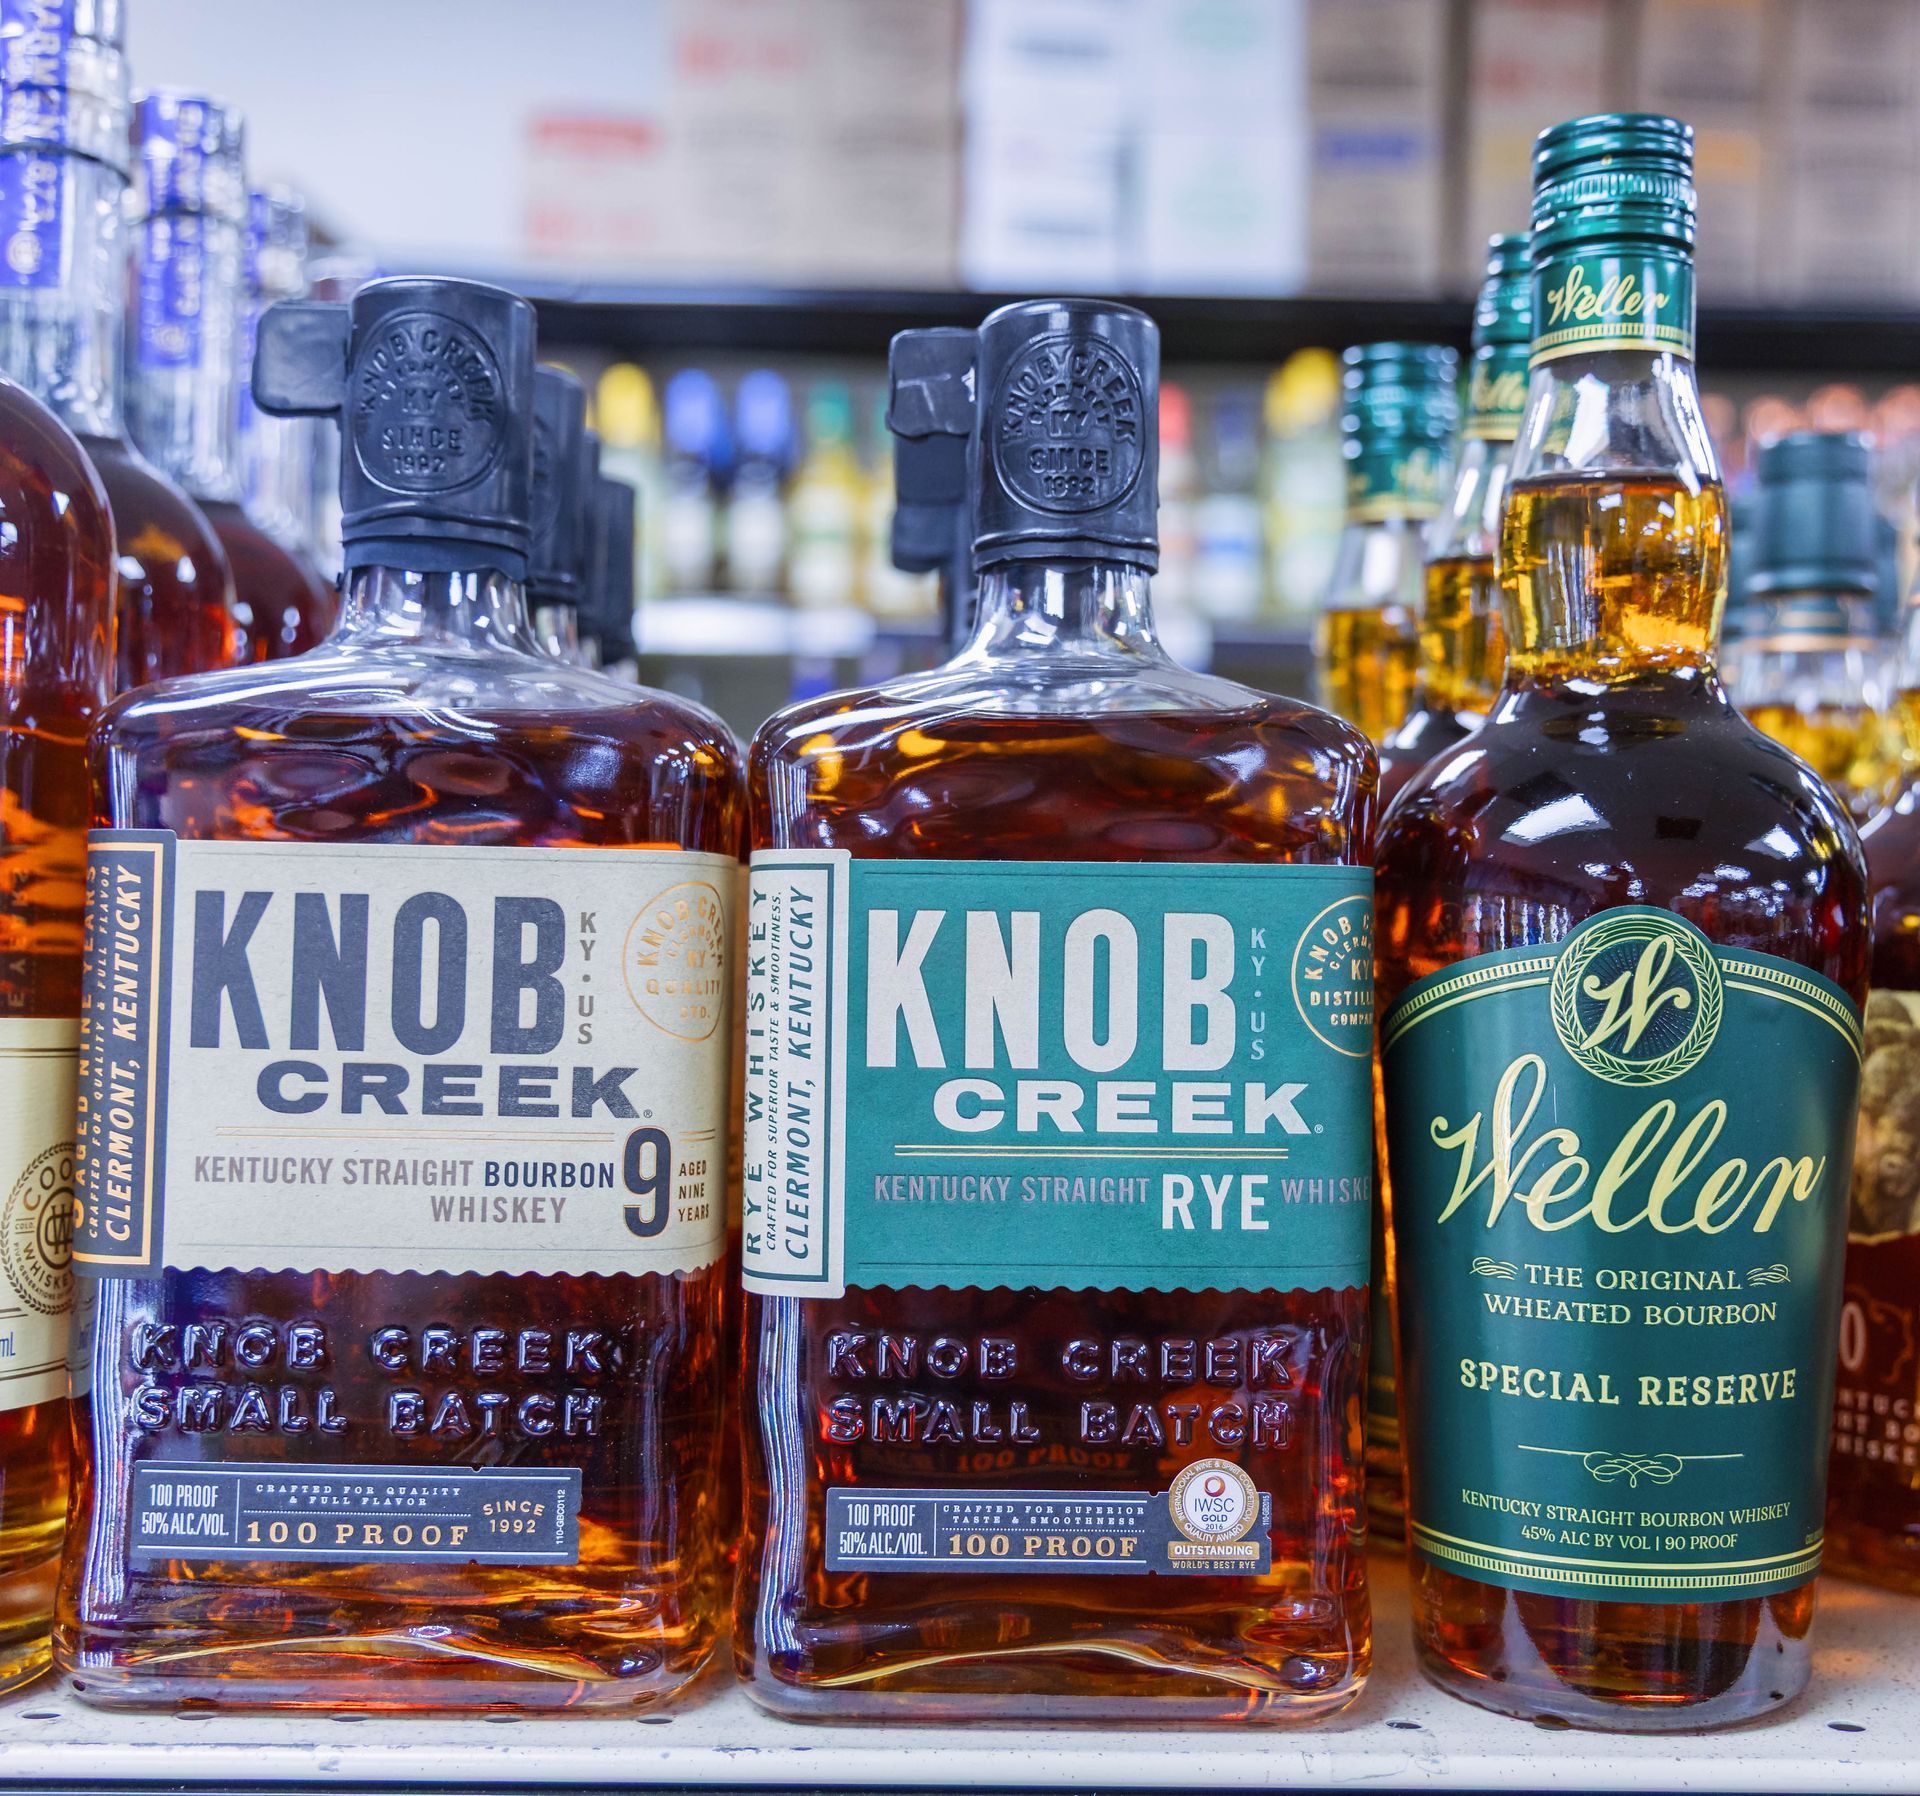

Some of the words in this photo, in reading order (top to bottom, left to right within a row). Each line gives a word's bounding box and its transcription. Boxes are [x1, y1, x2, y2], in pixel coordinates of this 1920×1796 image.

[1547, 264, 1669, 326] Weller
[361, 328, 412, 414] KNOB
[421, 328, 495, 425] CREEK
[1002, 355, 1058, 441] KNOB
[1071, 351, 1137, 446] CREEK
[382, 427, 465, 457] SINCE
[1028, 447, 1111, 475] SINCE
[100, 865, 111, 935] FLAVOR
[112, 864, 142, 1042] KENTUCKY
[637, 899, 691, 967] KNOB
[770, 890, 782, 996] SMOOTHNESS.
[1304, 915, 1352, 981] KNOB
[98, 947, 109, 990] FULL
[189, 889, 566, 1056] KNOB
[646, 978, 722, 996] QUALITY
[787, 885, 814, 1061] KENTUCKY
[1351, 959, 1370, 981] KY
[748, 887, 768, 1123] WHISKEY
[866, 908, 1237, 1073] KNOB
[78, 993, 91, 1077] NINE
[769, 1016, 780, 1062] TASTE
[94, 1022, 106, 1101] QUALITY
[767, 1068, 779, 1145] SUPERIOR
[92, 1111, 103, 1148] FOR
[1430, 1053, 1827, 1235] Weller
[105, 1058, 142, 1242] CLERMONT,
[678, 1159, 708, 1177] AGED
[767, 1149, 778, 1180] FOR
[785, 1079, 816, 1261] CLERMONT,
[194, 1155, 334, 1186] KENTUCKY
[342, 1157, 474, 1187] STRAIGHT
[484, 1160, 615, 1189] BOURBON
[622, 1125, 672, 1239] 9
[678, 1182, 706, 1200] NINE
[89, 1157, 101, 1239] CRAFTED
[430, 1195, 567, 1224] WHISKEY
[677, 1203, 710, 1223] YEARS
[746, 1162, 763, 1256] RYE
[766, 1184, 778, 1251] CRAFTED
[874, 1174, 1012, 1202] KENTUCKY
[1020, 1176, 1151, 1203] STRAIGHT
[1161, 1173, 1270, 1230] RYE
[1280, 1176, 1371, 1204] WHISKE
[23, 1241, 73, 1290] WHISKE
[1524, 1263, 1584, 1288] THE
[1595, 1269, 1743, 1291] ORIGINAL
[1483, 1293, 1631, 1324] WHEATED
[1644, 1302, 1777, 1326] BOURBON
[133, 1321, 330, 1371] KNOB
[369, 1325, 604, 1375] CREEK
[826, 1333, 1019, 1381] KNOB
[1062, 1336, 1294, 1387] CREEK
[1459, 1358, 1620, 1405] SPECIAL
[1638, 1368, 1797, 1407] RESERVE
[133, 1386, 348, 1433] SMALL
[388, 1388, 603, 1437] BATCH
[826, 1398, 1042, 1445] SMALL
[1080, 1400, 1291, 1450] BATCH
[150, 1484, 173, 1507] 100
[176, 1485, 219, 1508] PROOF
[255, 1484, 333, 1494] CRAFTED
[343, 1485, 375, 1495] FOR
[386, 1487, 462, 1497] QUALITY
[289, 1496, 298, 1505] &
[309, 1496, 351, 1505] FULL
[361, 1497, 428, 1507] FLAVOR
[482, 1499, 546, 1516] SINCE
[943, 1505, 1015, 1514] CRAFTED
[1025, 1505, 1054, 1514] FOR
[1064, 1506, 1145, 1515] SUPERIOR
[1174, 1469, 1196, 1521] INTERNATIONAL
[1194, 1460, 1213, 1473] WINE
[1222, 1461, 1241, 1476] SPIRIT
[1240, 1474, 1255, 1522] COMPETITION
[1193, 1498, 1235, 1513] IWSC
[1461, 1488, 1543, 1518] KENTUCKY
[1546, 1505, 1636, 1527] STRAIGHT
[1639, 1510, 1724, 1528] BOURBON
[1729, 1501, 1791, 1525] WHISKEY
[141, 1511, 169, 1535] 50%
[247, 1521, 318, 1544] 100
[335, 1523, 469, 1546] PROOF
[489, 1519, 537, 1533] 1992
[847, 1503, 870, 1526] 100
[873, 1504, 916, 1527] PROOF
[952, 1515, 1001, 1524] TASTE
[1011, 1516, 1020, 1525] &
[1030, 1516, 1136, 1526] SMOOTHNESS
[1184, 1522, 1215, 1543] QUALITY
[1215, 1523, 1244, 1543] AWARD
[1201, 1514, 1229, 1523] GOLD
[1205, 1523, 1224, 1531] 2016
[839, 1531, 867, 1555] 50%
[949, 1533, 1010, 1556] 100
[1023, 1536, 1138, 1557] PROOF
[1174, 1545, 1253, 1556] OUTSTANDING
[1521, 1525, 1556, 1543] 45%
[1559, 1532, 1591, 1546] ALC
[1594, 1534, 1614, 1548] BY
[1618, 1535, 1651, 1550] VOL
[1664, 1535, 1686, 1551] 90
[1689, 1533, 1739, 1549] PROOF
[1172, 1560, 1210, 1569] WORLD'S
[1213, 1561, 1236, 1569] BEST
[1238, 1561, 1257, 1569] RYE
